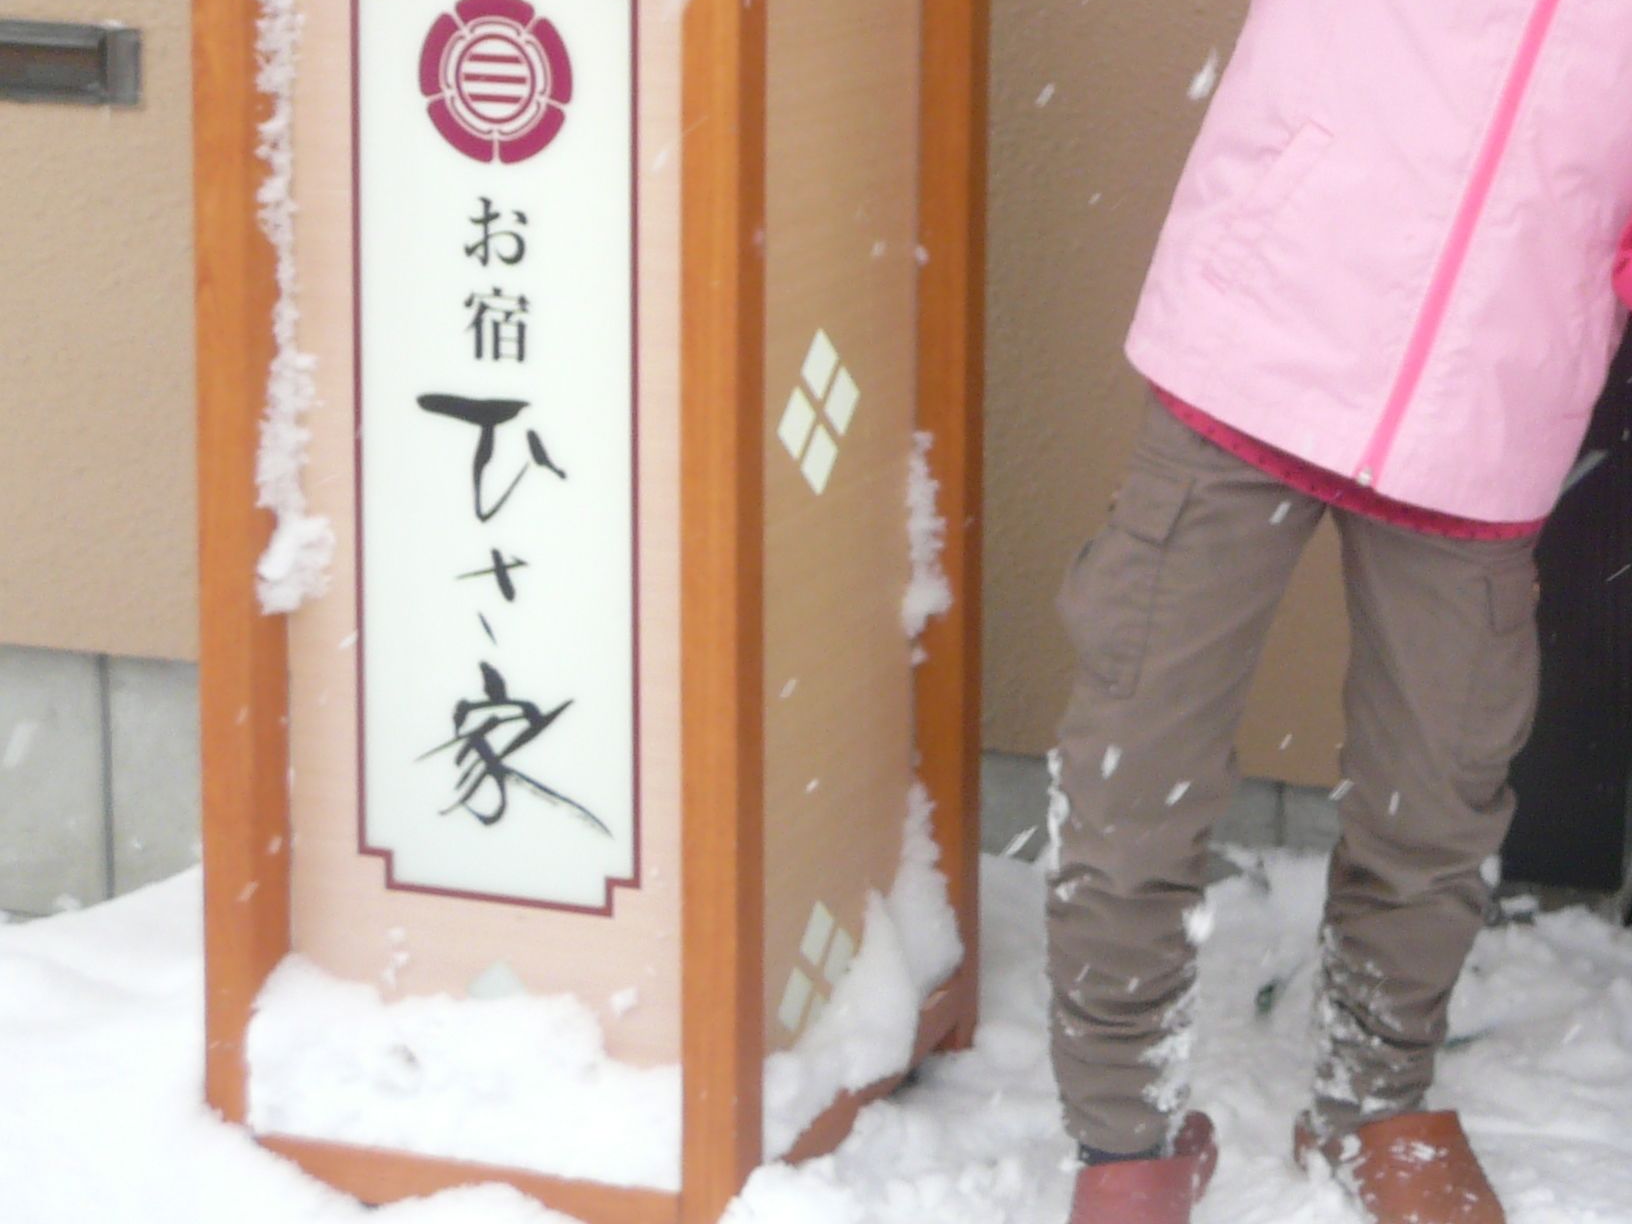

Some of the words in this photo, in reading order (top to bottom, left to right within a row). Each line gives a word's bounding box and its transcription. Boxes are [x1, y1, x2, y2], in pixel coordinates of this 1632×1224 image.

[463, 196, 530, 363] お宿
[415, 392, 614, 840] ひさ家
